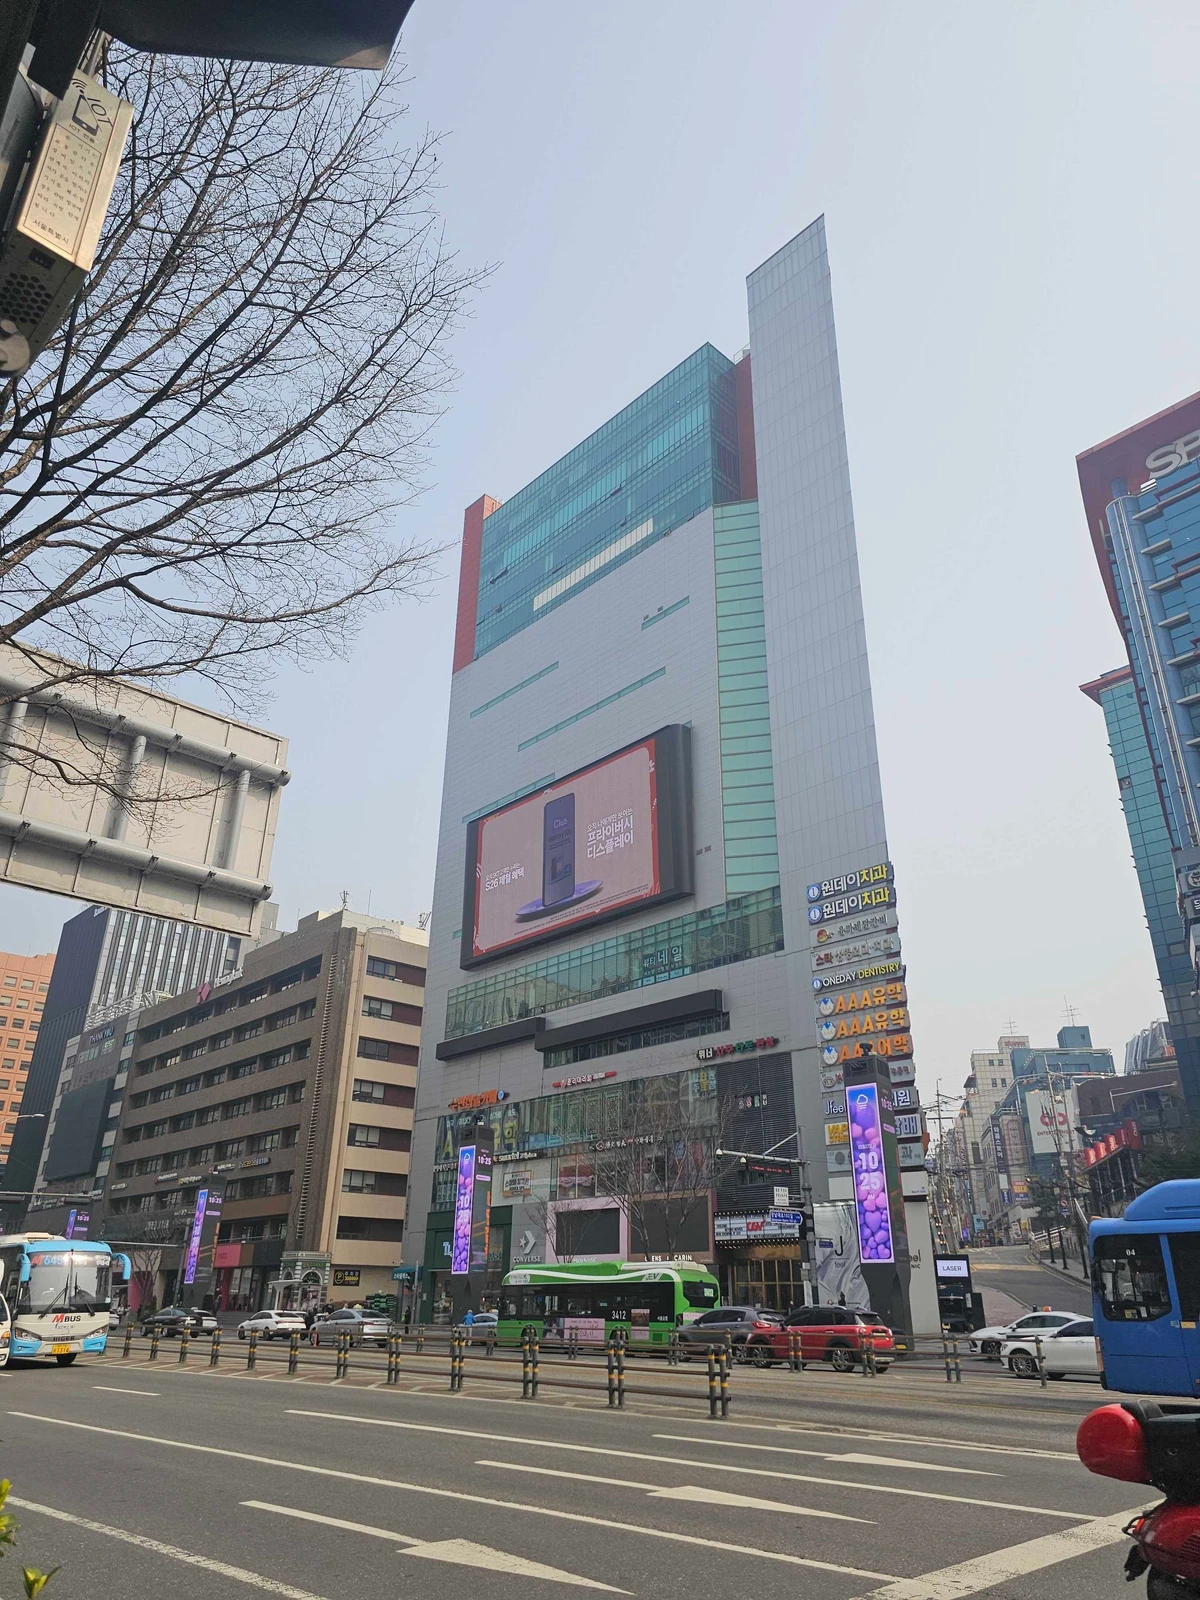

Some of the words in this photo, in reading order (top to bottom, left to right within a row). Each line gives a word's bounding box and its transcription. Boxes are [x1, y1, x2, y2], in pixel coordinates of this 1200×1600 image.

[87, 97, 114, 128] IOT
[69, 123, 81, 134] IOT
[32, 219, 69, 244] 서울특별시
[553, 818, 568, 829] Club
[587, 815, 633, 845] 프라이버시
[587, 830, 634, 860] 디스플레이
[485, 877, 498, 892] S26
[821, 864, 888, 896] 원데이치과
[822, 886, 890, 919] 원데이치과
[822, 972, 857, 987] ONEDAY
[858, 962, 900, 979] DENTISTRY
[835, 982, 903, 1014] AAA유학
[836, 1006, 905, 1038] AAA유학
[698, 1047, 714, 1060] 위너
[858, 1151, 879, 1170] 10
[859, 1171, 881, 1190] 25
[459, 1194, 470, 1208] 10
[458, 1209, 470, 1223] 25
[834, 1235, 844, 1257] J
[1125, 1248, 1136, 1256] 04
[513, 1255, 542, 1263] CONVERSE
[673, 1254, 692, 1262] CARIN
[611, 1310, 626, 1320] 3412
